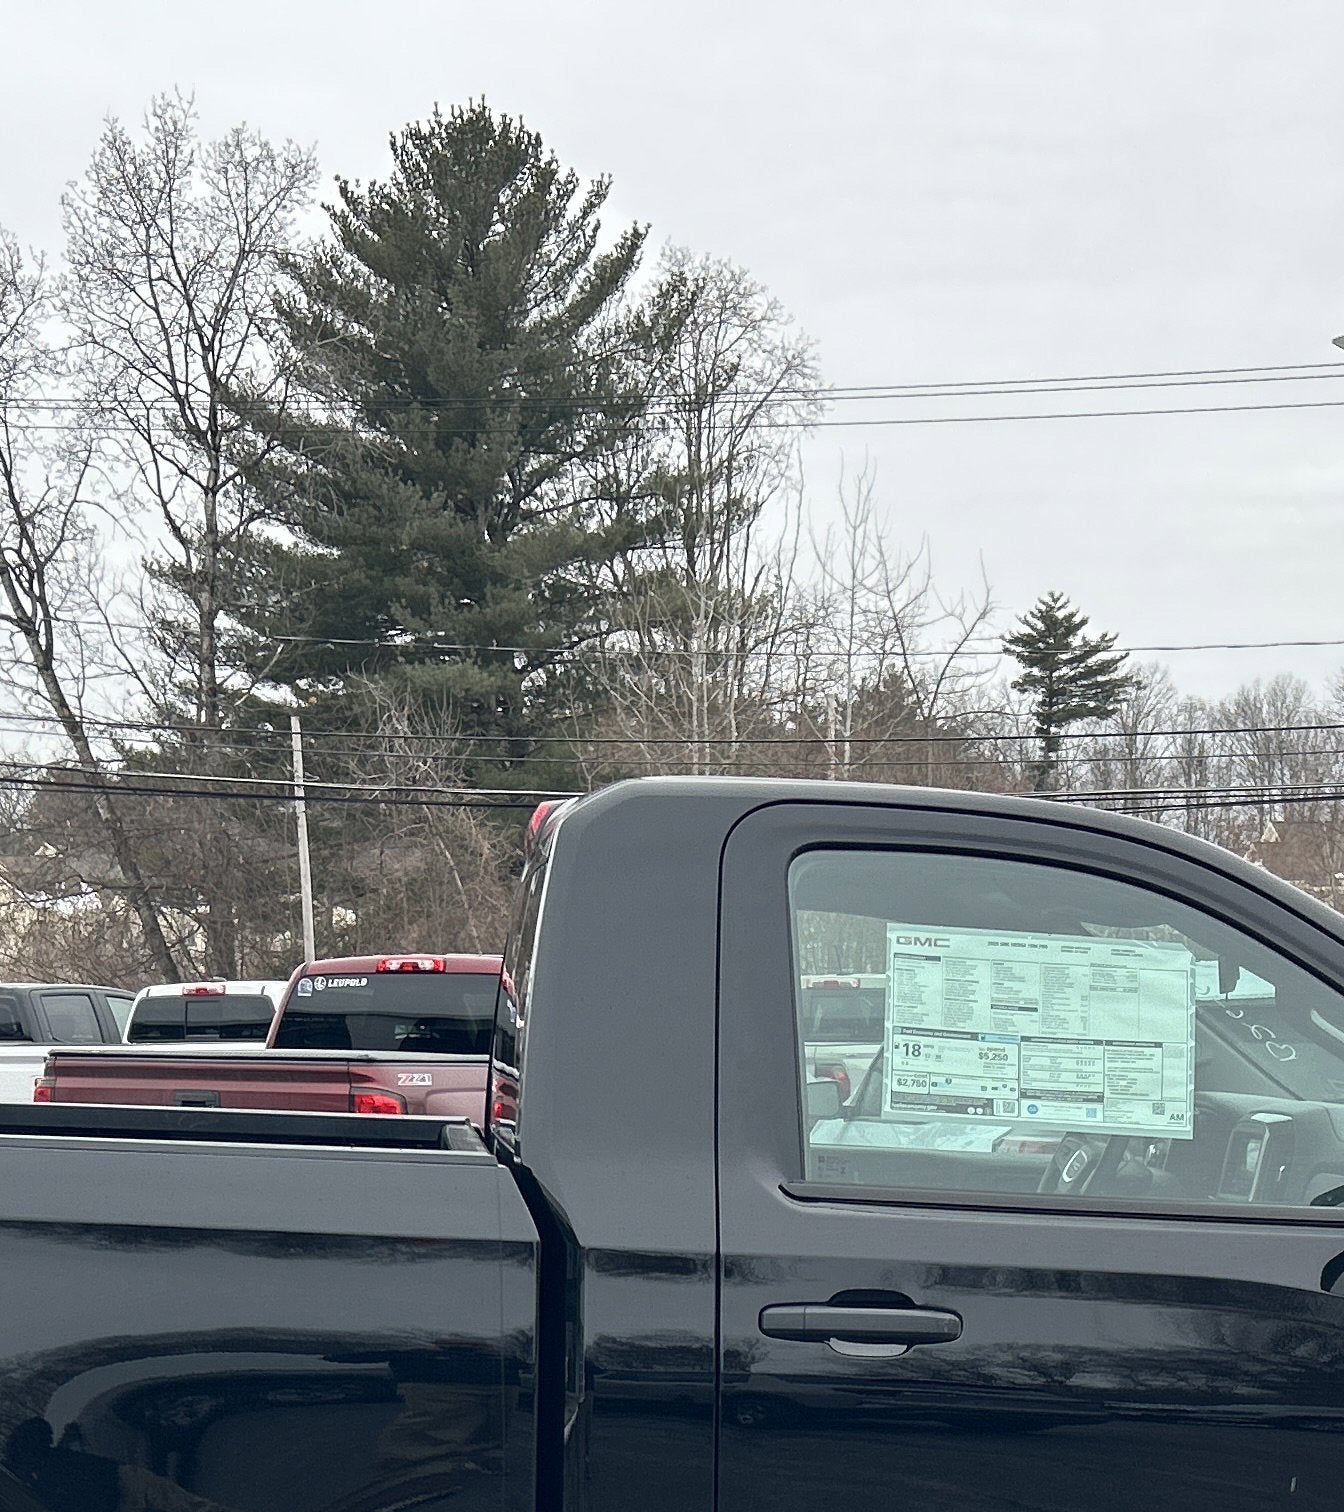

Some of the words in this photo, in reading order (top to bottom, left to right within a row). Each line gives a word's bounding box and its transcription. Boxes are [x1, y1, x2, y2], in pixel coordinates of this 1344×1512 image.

[896, 936, 950, 948] GMC
[327, 977, 368, 987] LEUPOLD
[902, 1042, 922, 1058] 18
[397, 1073, 433, 1086] Z71
